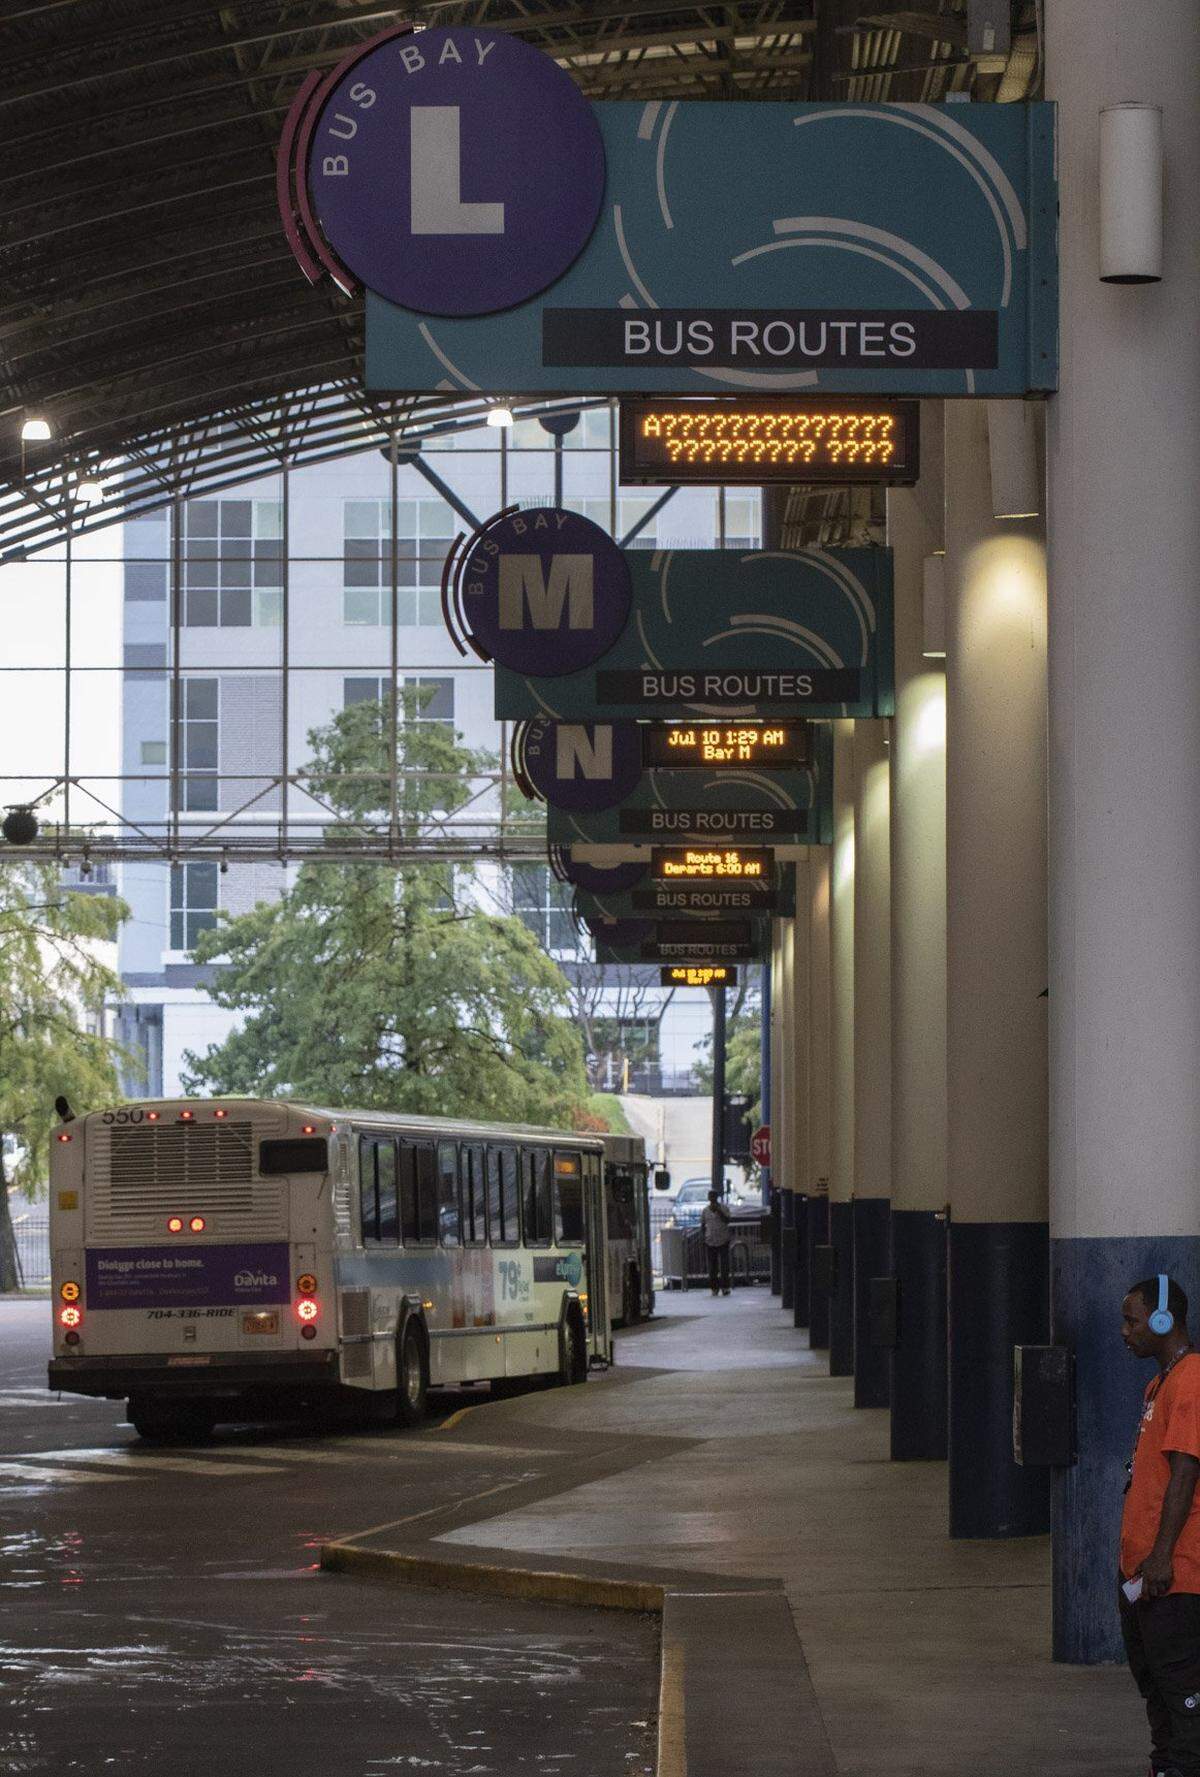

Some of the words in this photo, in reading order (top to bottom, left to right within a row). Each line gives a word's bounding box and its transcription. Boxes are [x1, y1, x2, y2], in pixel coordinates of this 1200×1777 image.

[323, 82, 377, 176] BUS
[400, 38, 496, 74] BAY
[410, 105, 505, 235] L
[624, 320, 714, 355] BUS
[731, 321, 916, 356] ROUTES
[468, 539, 500, 595] BUS
[512, 513, 568, 535] BAY
[499, 553, 594, 630] M
[643, 676, 696, 697] BUS
[705, 675, 813, 696] ROUTES
[669, 731, 696, 745] Jul
[702, 731, 720, 745] 10
[726, 731, 758, 745] 1:29
[763, 731, 784, 745] AM
[556, 724, 613, 780] N
[704, 745, 733, 760] Bay
[739, 745, 751, 759] M
[652, 813, 690, 829] BUS
[697, 813, 774, 829] ROUTES
[686, 852, 721, 864] Route
[657, 893, 687, 906] BUS
[692, 893, 751, 906] ROUTES
[660, 943, 686, 955] BUS
[688, 943, 737, 955] ROUTES
[102, 1107, 144, 1125] 550
[753, 1138, 771, 1155] ST
